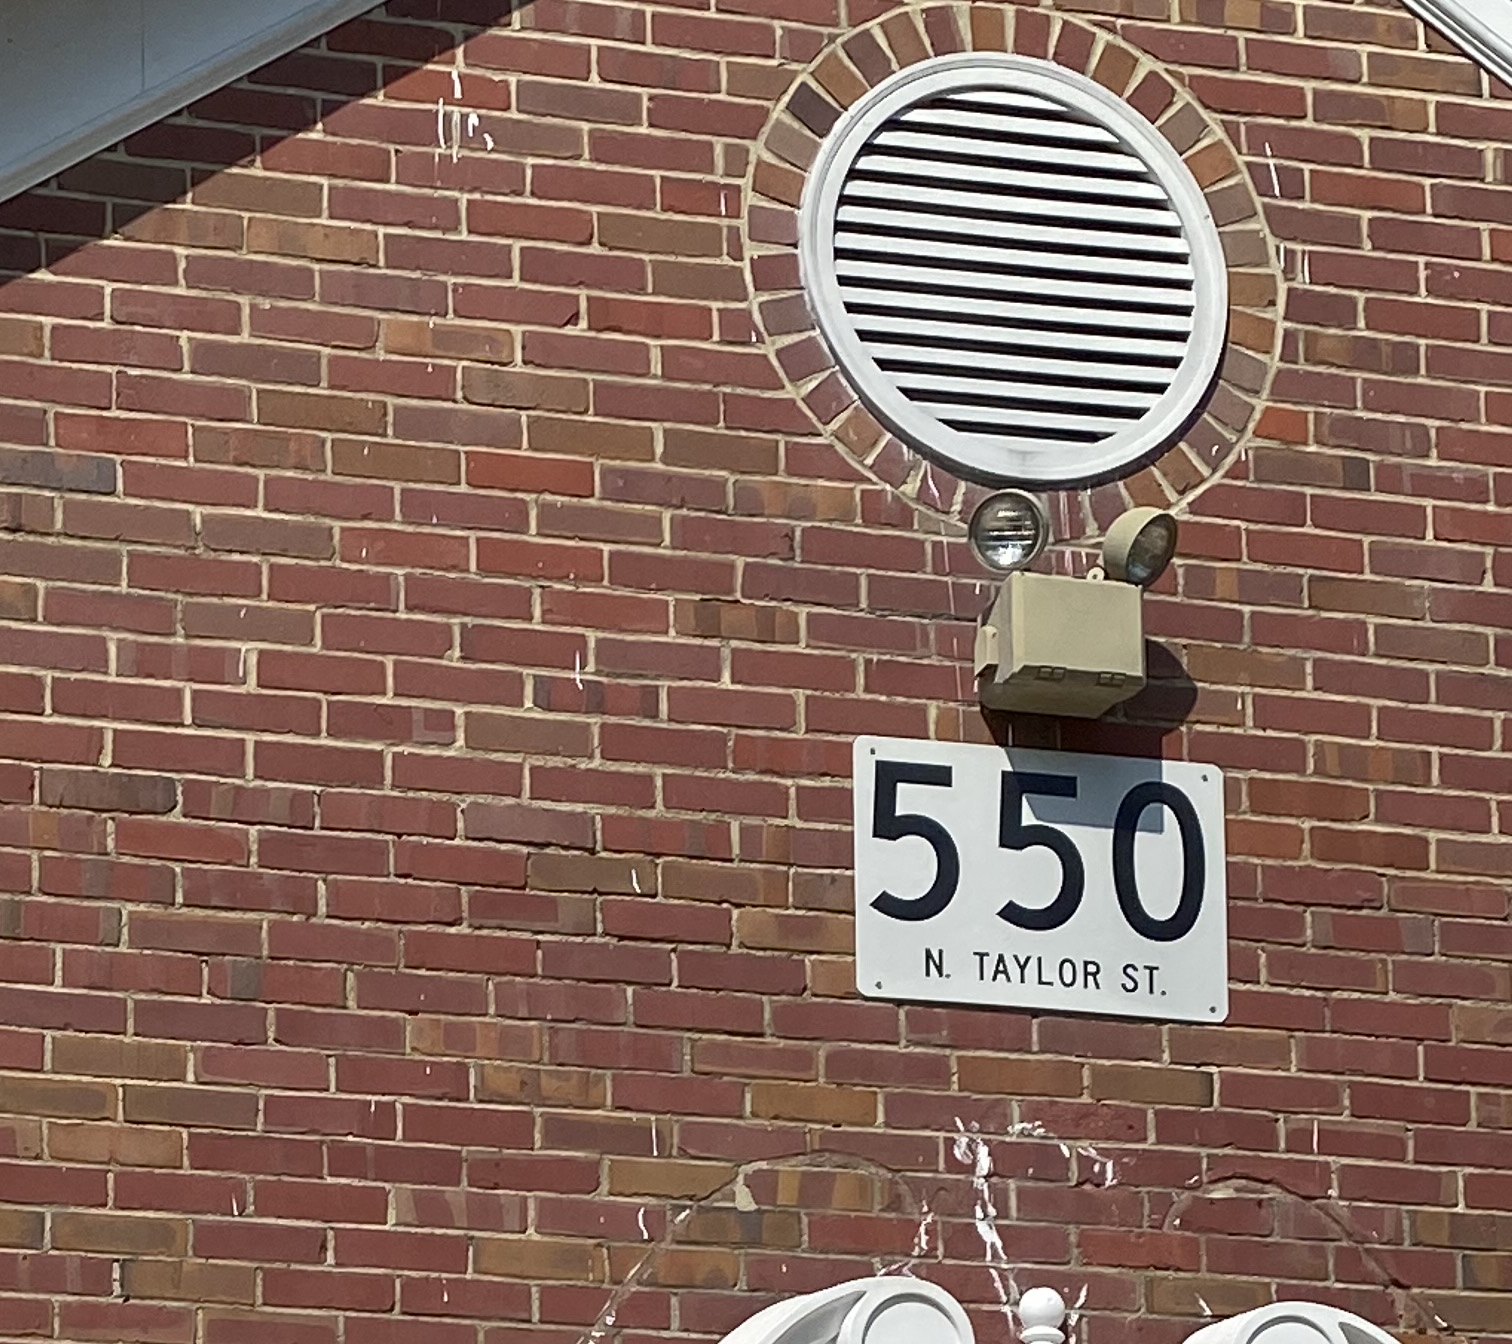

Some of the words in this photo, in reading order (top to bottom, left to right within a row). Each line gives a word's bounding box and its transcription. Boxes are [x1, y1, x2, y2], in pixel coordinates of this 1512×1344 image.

[869, 759, 1206, 943] 550
[924, 948, 952, 980] N.
[973, 951, 1101, 990] TAYLOR
[1120, 963, 1168, 997] ST.
